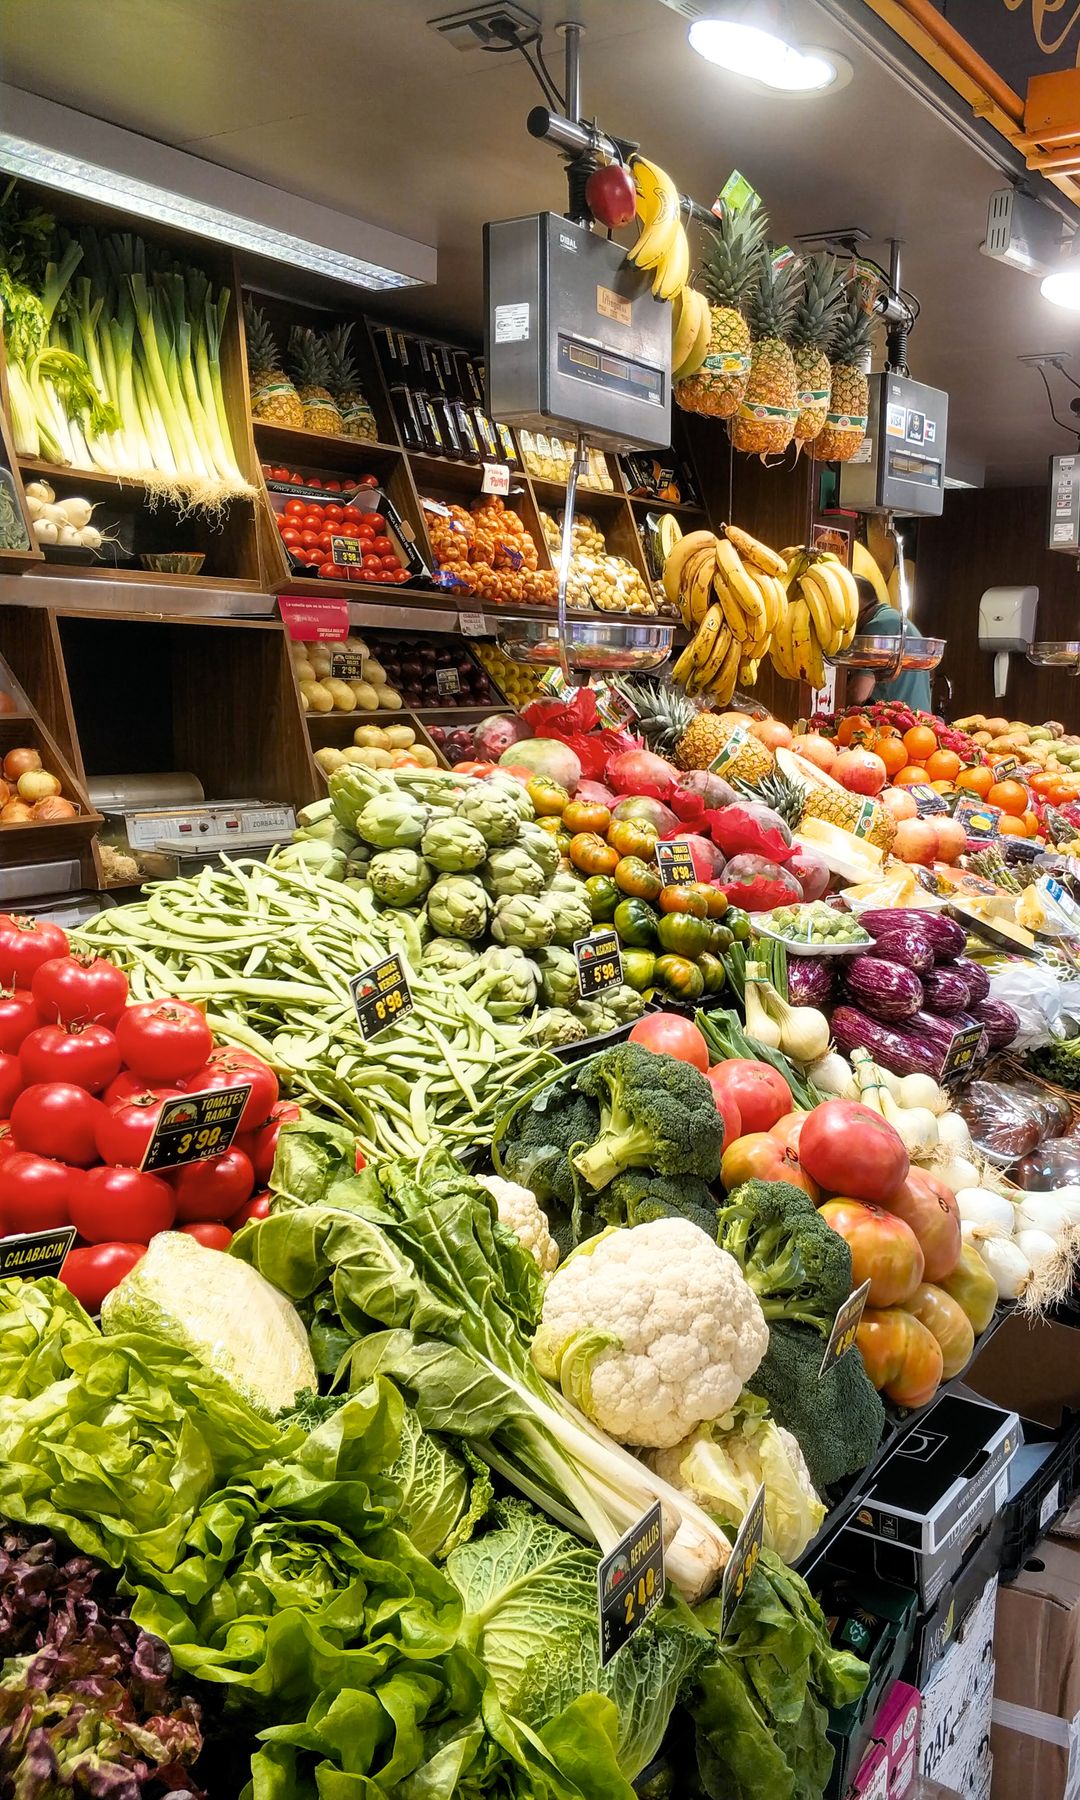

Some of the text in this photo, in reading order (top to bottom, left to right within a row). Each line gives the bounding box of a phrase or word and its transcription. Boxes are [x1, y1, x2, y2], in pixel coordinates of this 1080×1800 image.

[201, 1091, 246, 1111] TOMATES
[203, 1107, 232, 1123] RAMA
[200, 1145, 226, 1157] KILO
[4, 1241, 66, 1268] CALABACIN
[630, 1520, 659, 1569] REPOLLOS
[644, 1588, 662, 1615] KILO
